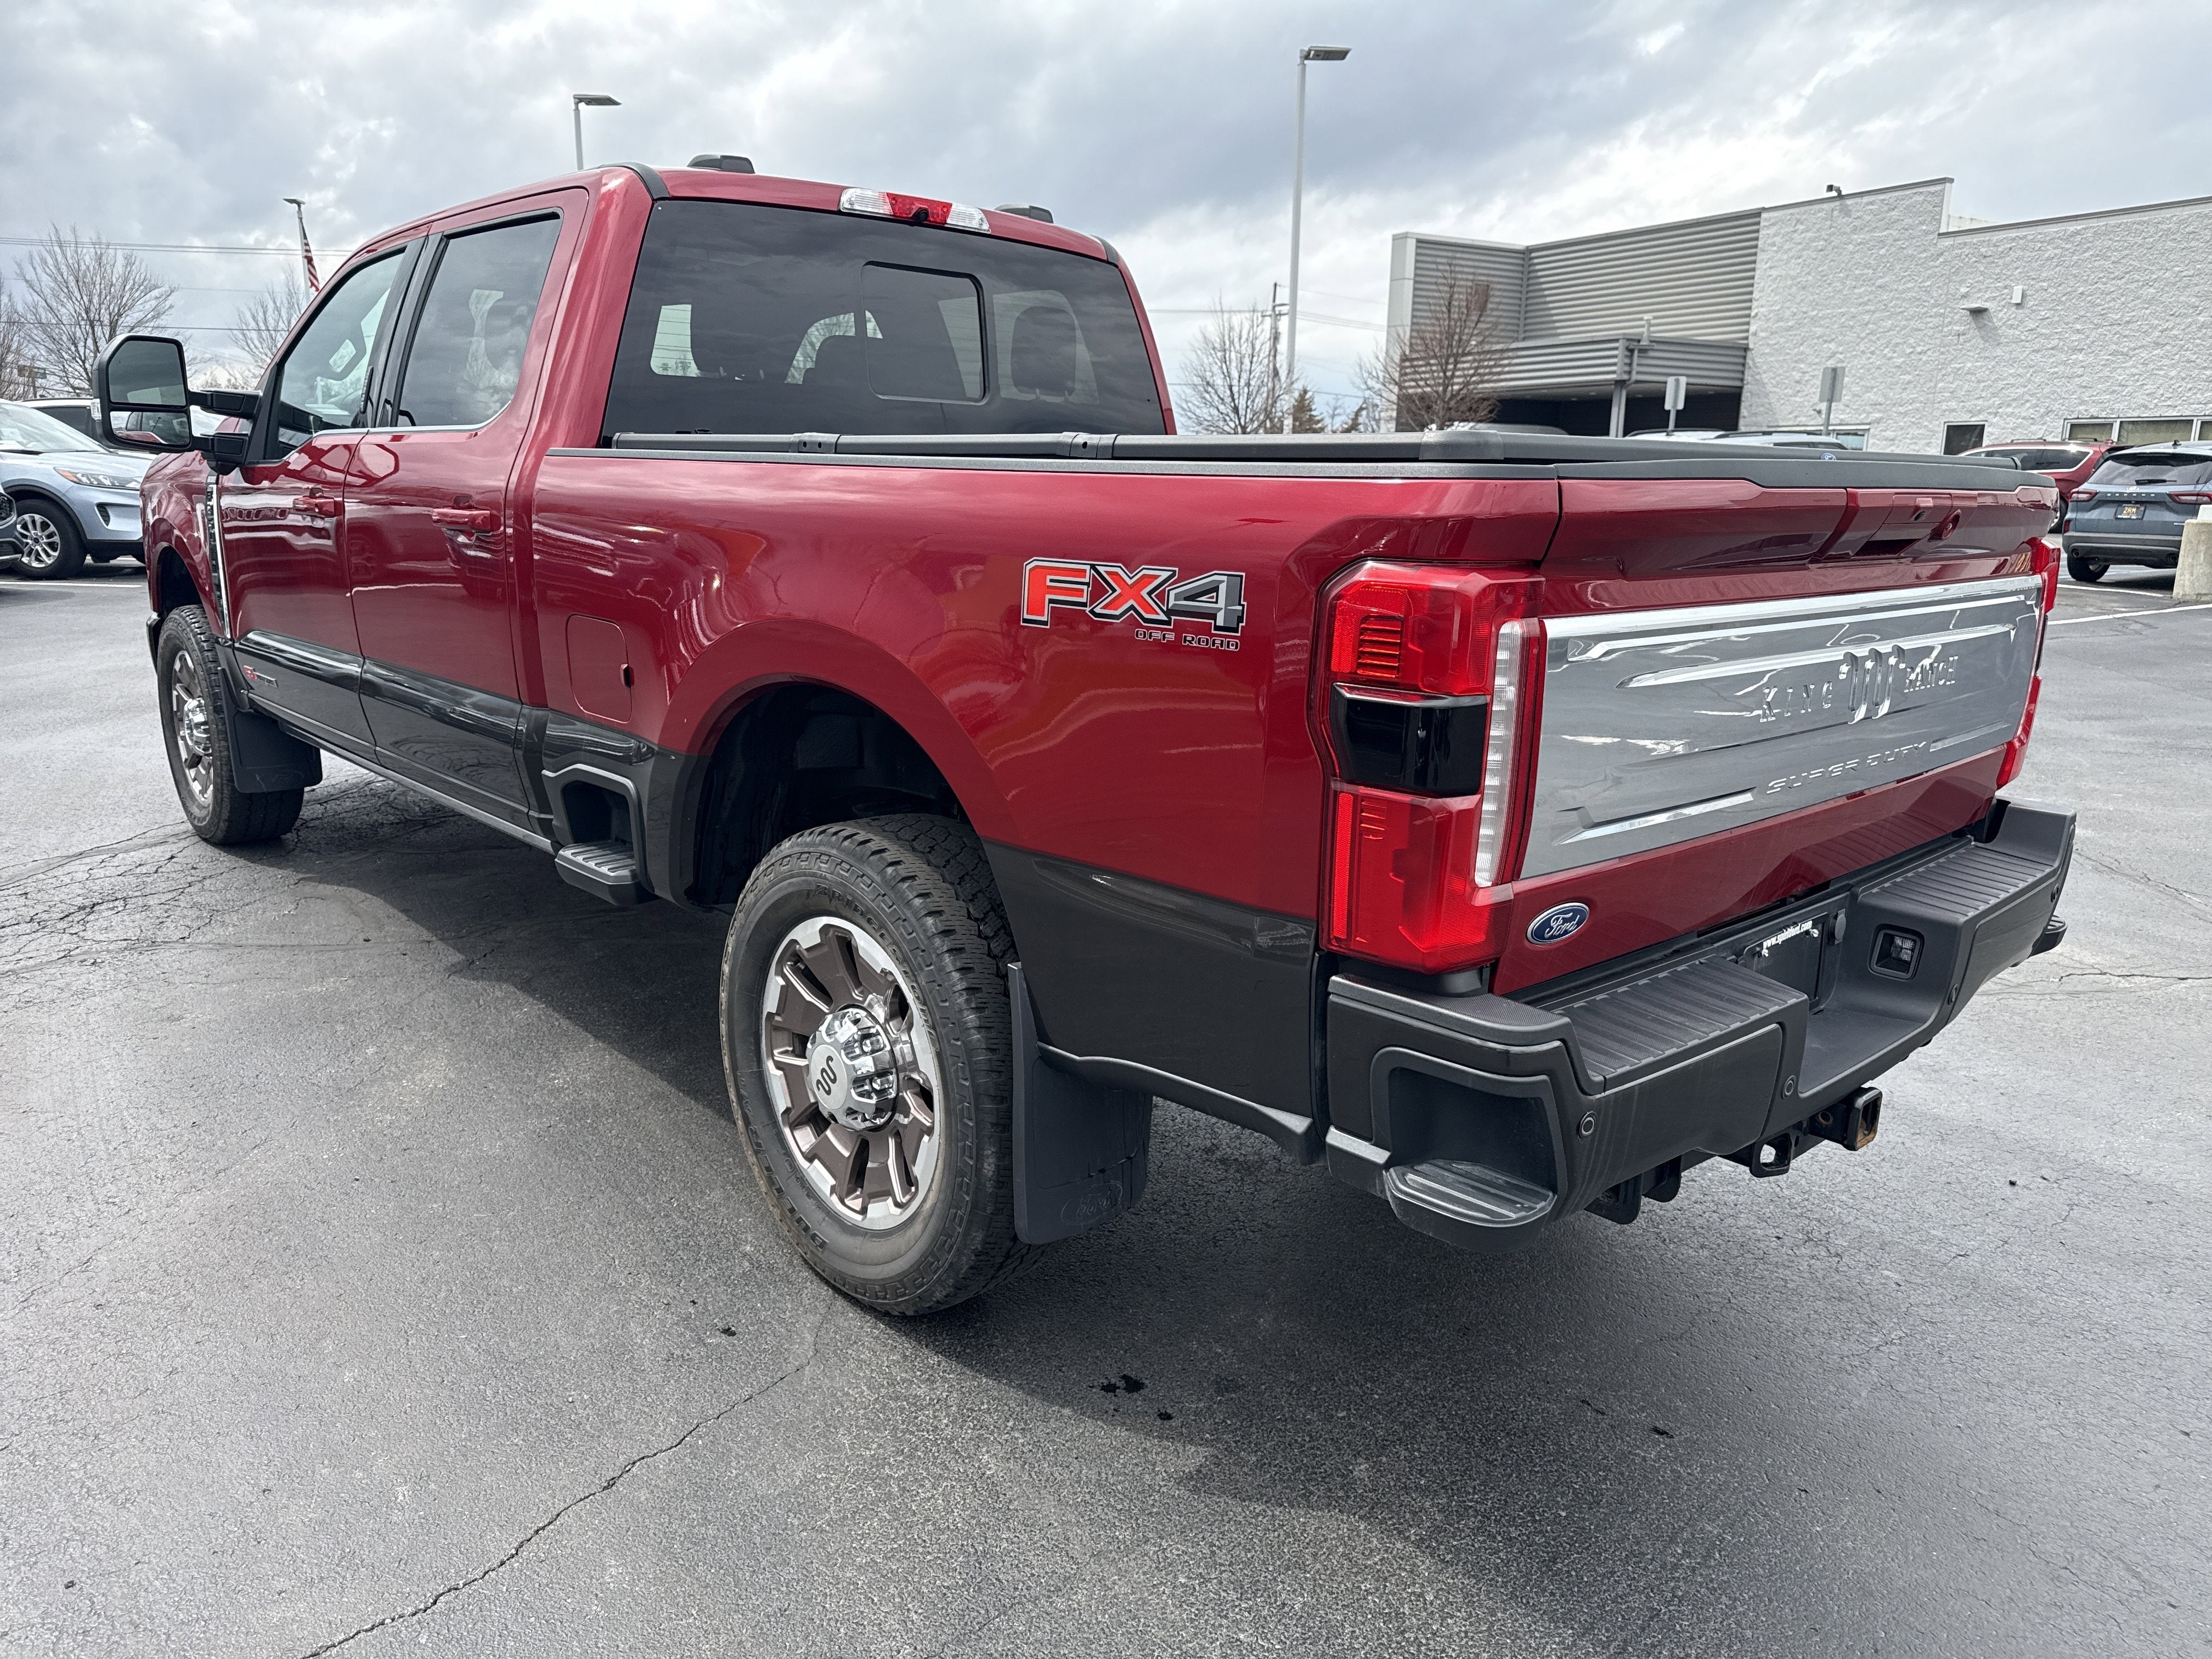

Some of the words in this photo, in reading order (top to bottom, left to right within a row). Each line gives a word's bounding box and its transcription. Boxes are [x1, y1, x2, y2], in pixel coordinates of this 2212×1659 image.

[1020, 557, 1246, 635] FX4
[1135, 629, 1175, 642] OFF
[1182, 634, 1240, 651] ROAD
[1760, 681, 1832, 722] KING
[1904, 654, 1959, 692] RANCH
[1767, 759, 1859, 794] SUPER
[1865, 742, 1926, 768] DUTY
[1544, 912, 1580, 938] Ford
[815, 882, 940, 1052] BRIDGESTONE
[748, 1126, 829, 1251] DUELER
